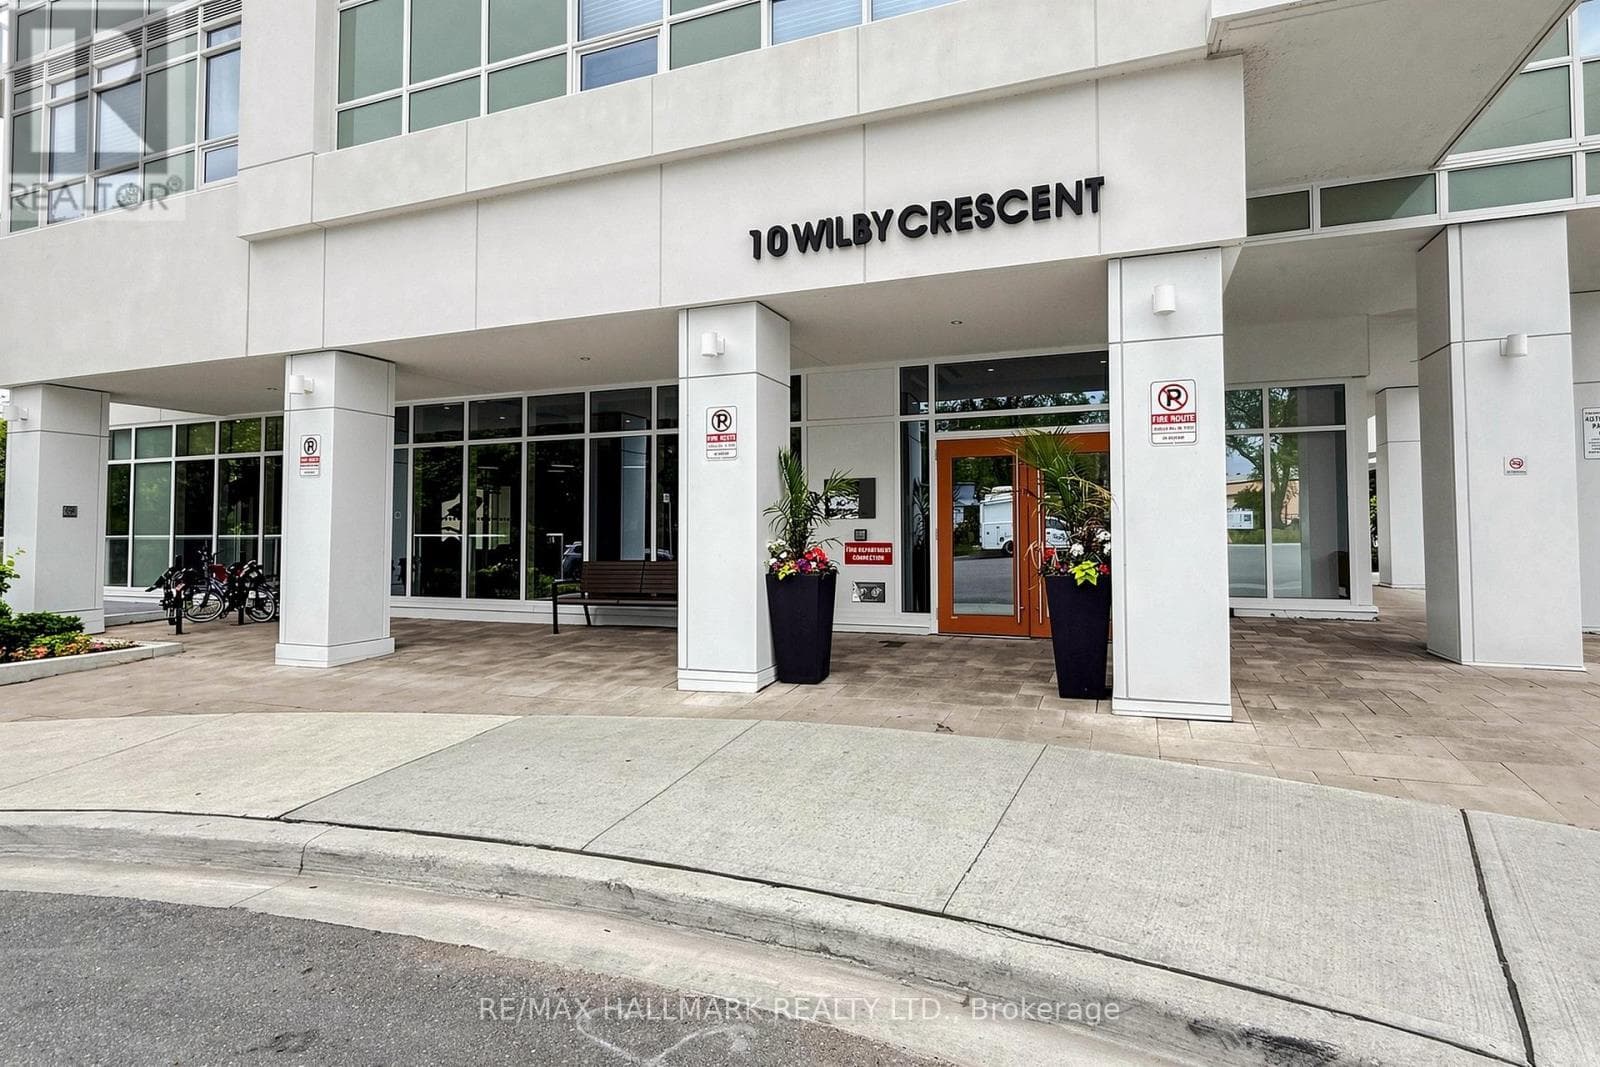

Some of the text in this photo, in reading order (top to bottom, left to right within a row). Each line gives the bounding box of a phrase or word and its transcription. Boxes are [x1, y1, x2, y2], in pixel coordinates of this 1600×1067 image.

[750, 176, 1105, 261] 10 WILBY CRESCENT
